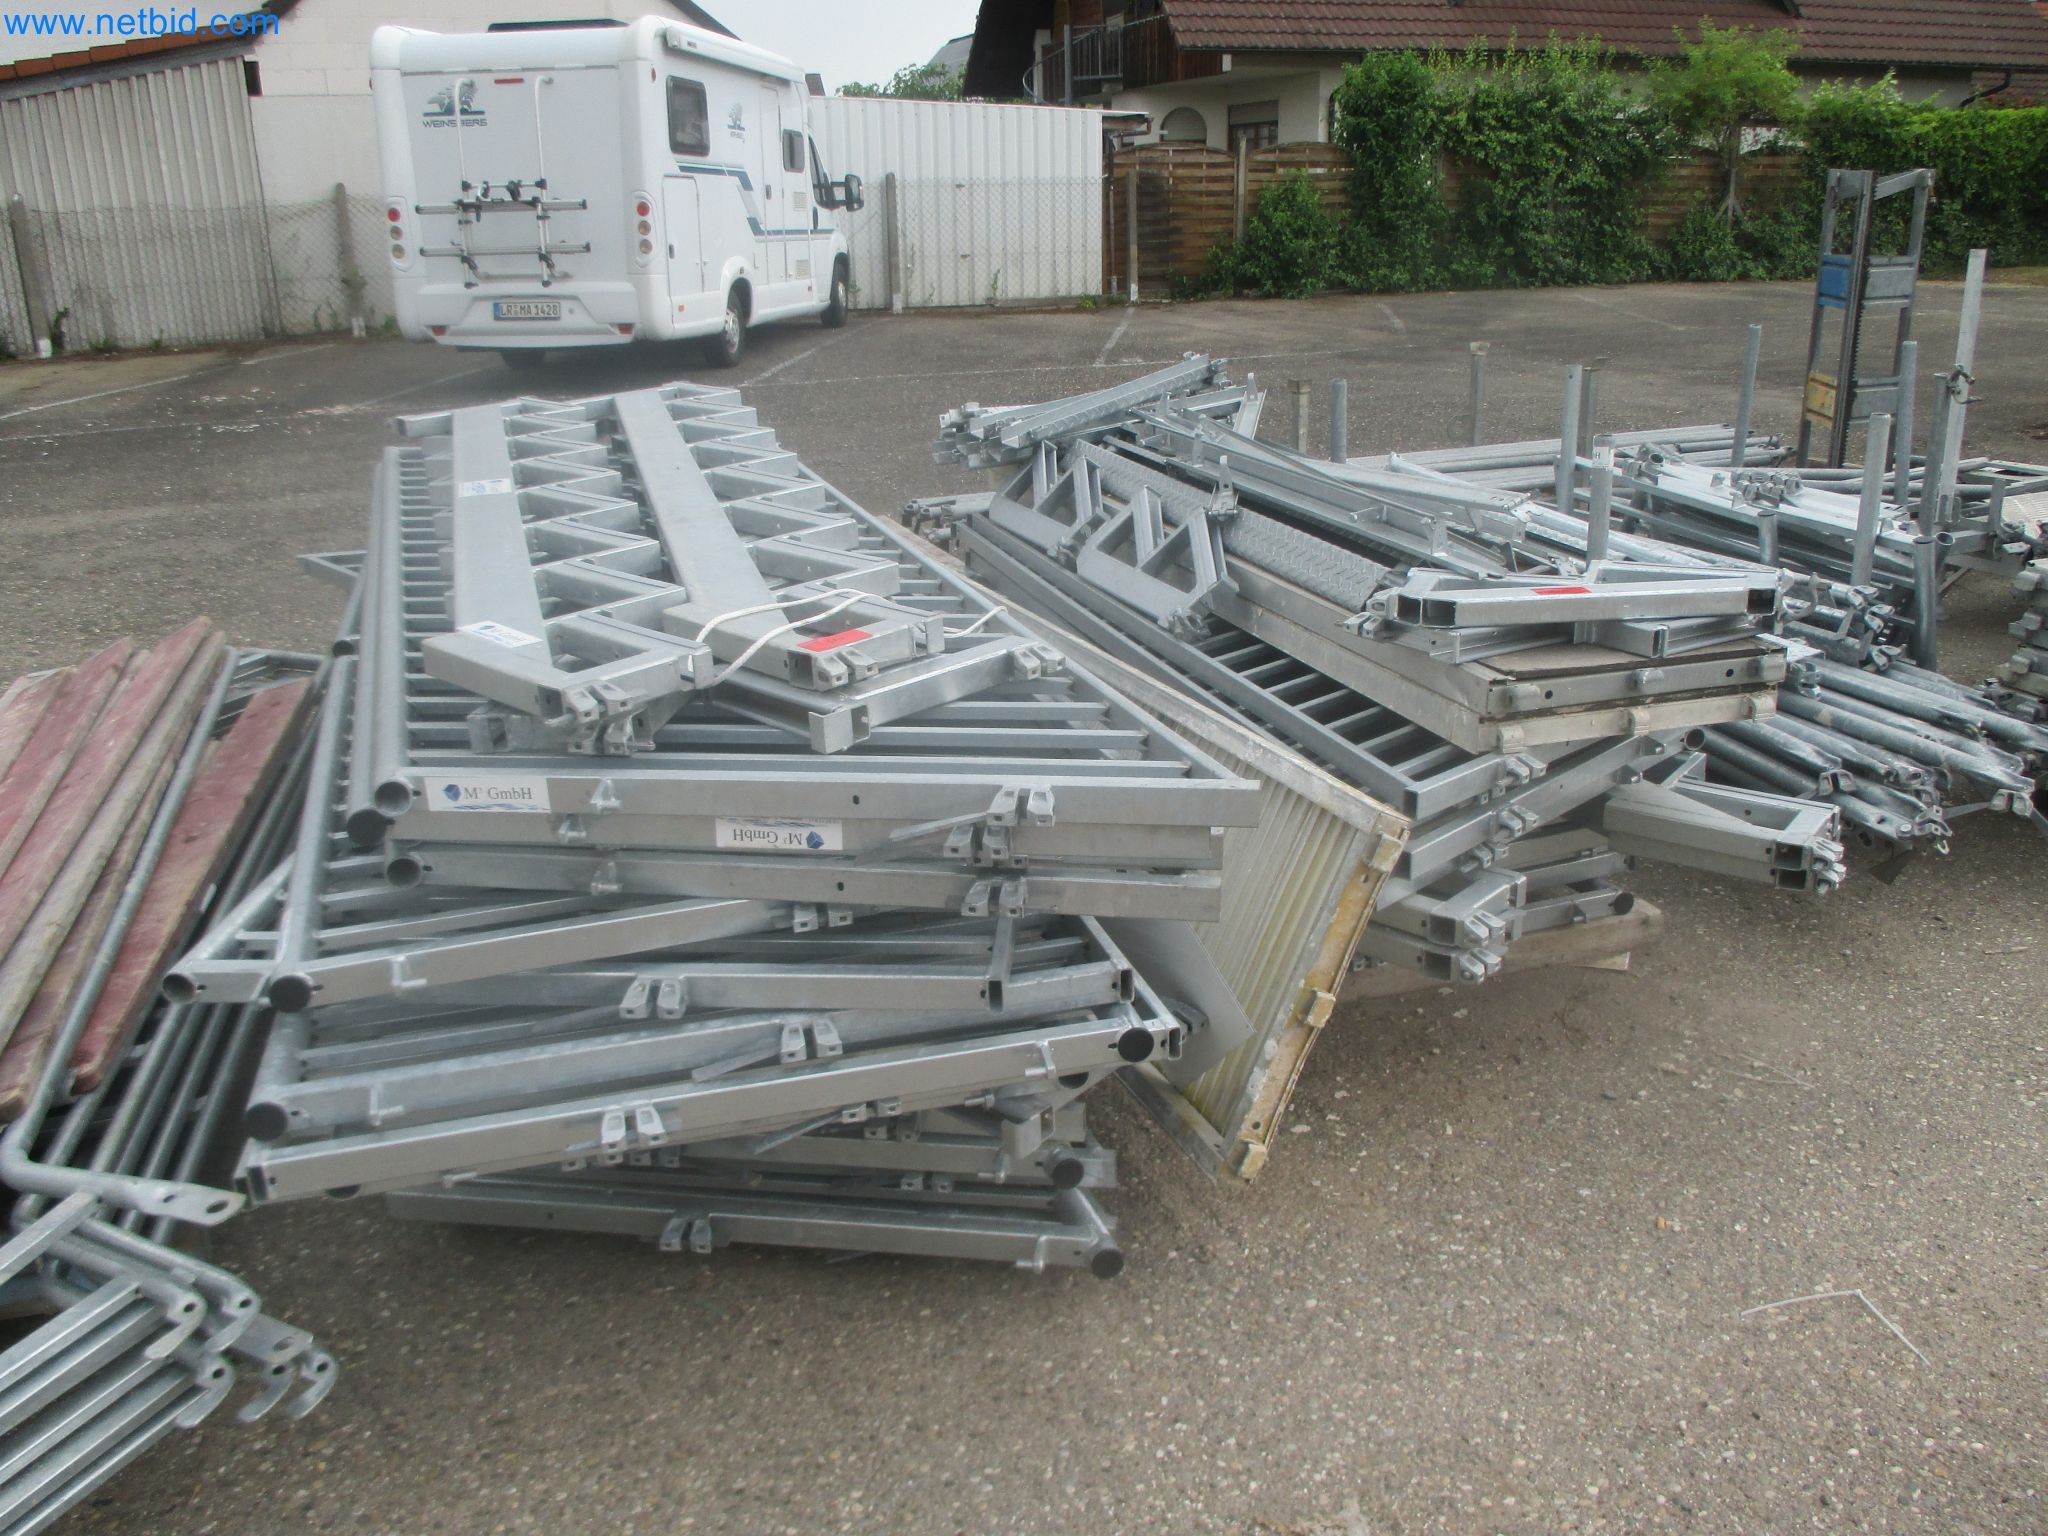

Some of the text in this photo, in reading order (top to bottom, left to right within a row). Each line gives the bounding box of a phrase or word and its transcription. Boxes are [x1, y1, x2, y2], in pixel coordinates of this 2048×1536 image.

[501, 305, 513, 316] LR
[487, 787, 533, 800] GmbH
[733, 828, 779, 844] GmbH
